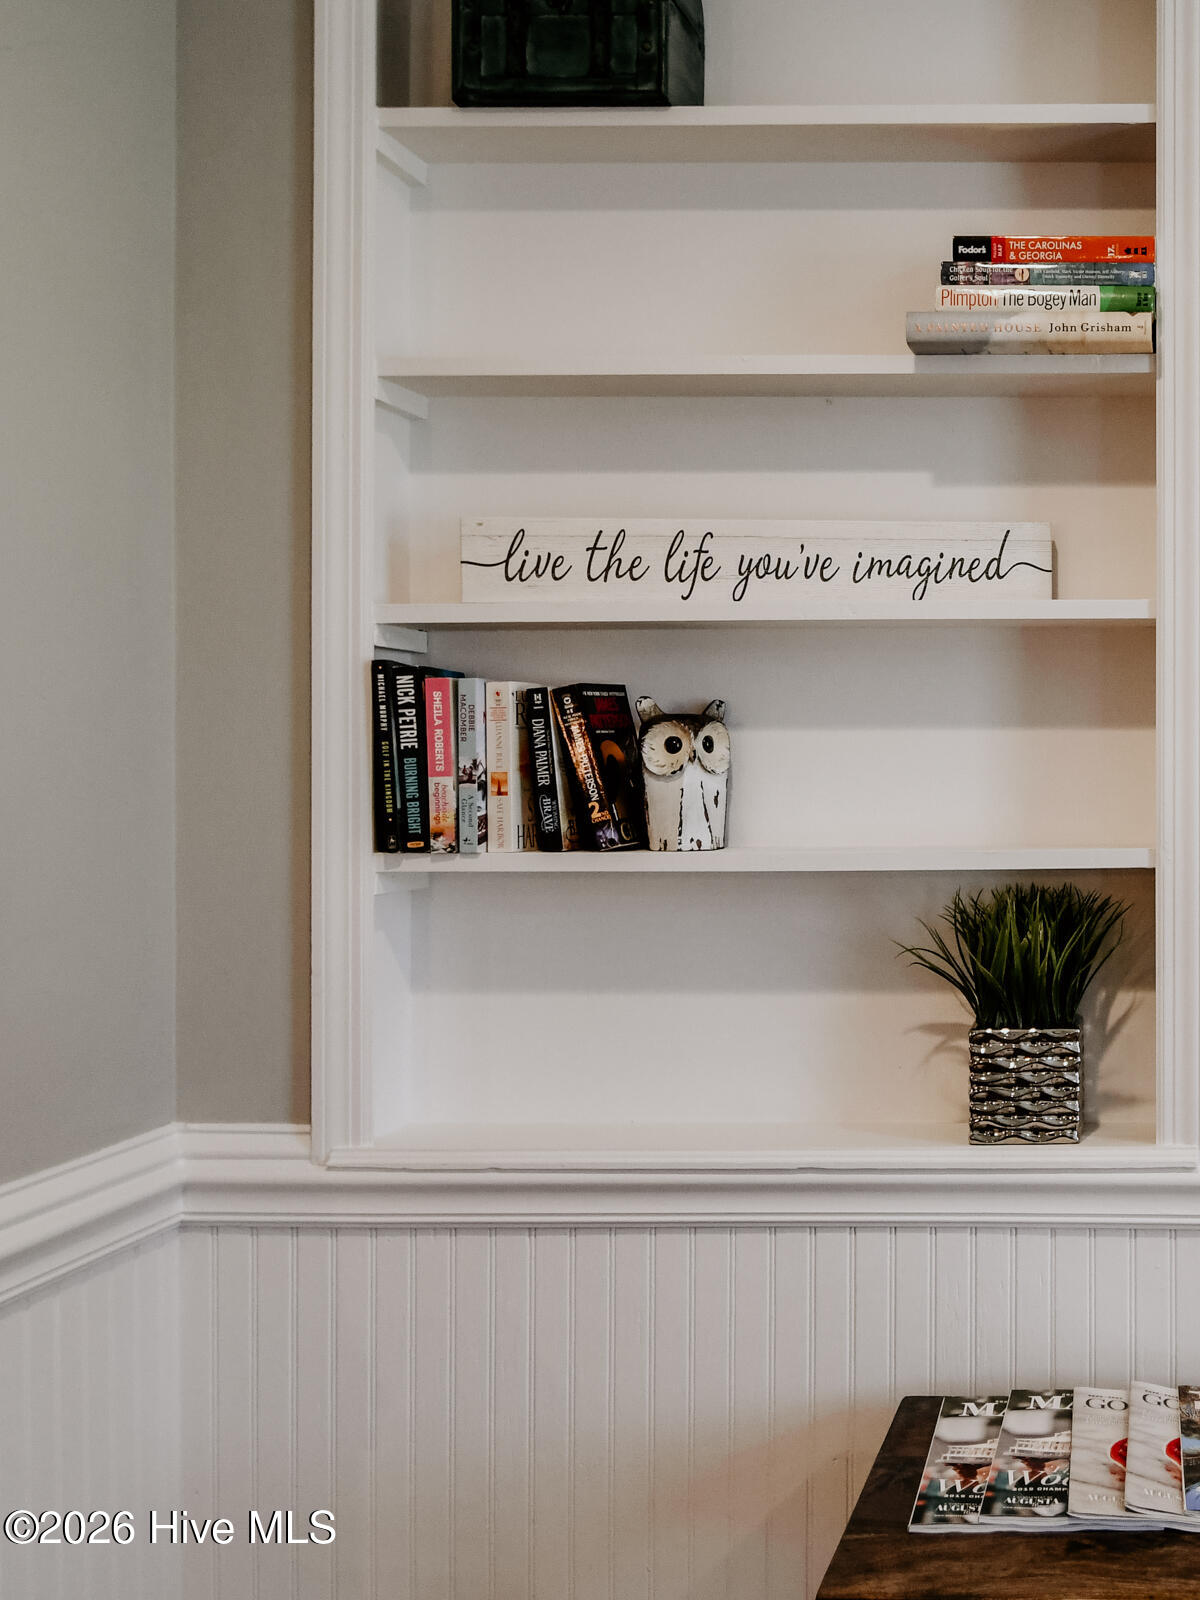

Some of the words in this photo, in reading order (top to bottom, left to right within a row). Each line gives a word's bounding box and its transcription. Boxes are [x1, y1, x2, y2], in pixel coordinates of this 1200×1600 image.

[1008, 240, 1026, 250] THE
[1028, 240, 1083, 251] CAROLINAS
[1009, 251, 1017, 260] &
[1018, 250, 1063, 260] GEORGIA
[949, 265, 974, 274] Chicken
[940, 288, 998, 311] Plimpton
[1001, 289, 1025, 307] The
[1027, 288, 1067, 311] Bogey
[1069, 289, 1097, 307] Man
[993, 322, 1042, 333] HOUSE
[1048, 321, 1078, 334] John
[1080, 321, 1133, 333] Grisham
[460, 528, 573, 583] live
[585, 528, 650, 583] the
[664, 529, 722, 601] life
[732, 543, 841, 602] you've
[851, 529, 1053, 601] imagined
[376, 673, 387, 703] MICHAEL
[395, 674, 416, 706] NICK
[379, 704, 389, 732] MURPHY
[432, 690, 444, 727] SHEILA
[459, 694, 468, 742] MACOMBER
[467, 704, 476, 732] DEBBIE
[398, 708, 419, 750] PETRIE
[531, 718, 547, 749] DIANA
[433, 728, 445, 773] ROBERTS
[403, 757, 420, 799] BURNING
[534, 750, 551, 787] PALMER
[578, 752, 600, 801] PATTERSON
[406, 801, 422, 834] BRIGHT
[432, 782, 441, 825] beginnings
[542, 798, 555, 833] BRAVE
[1003, 1495, 1061, 1505] AUGUSTA
